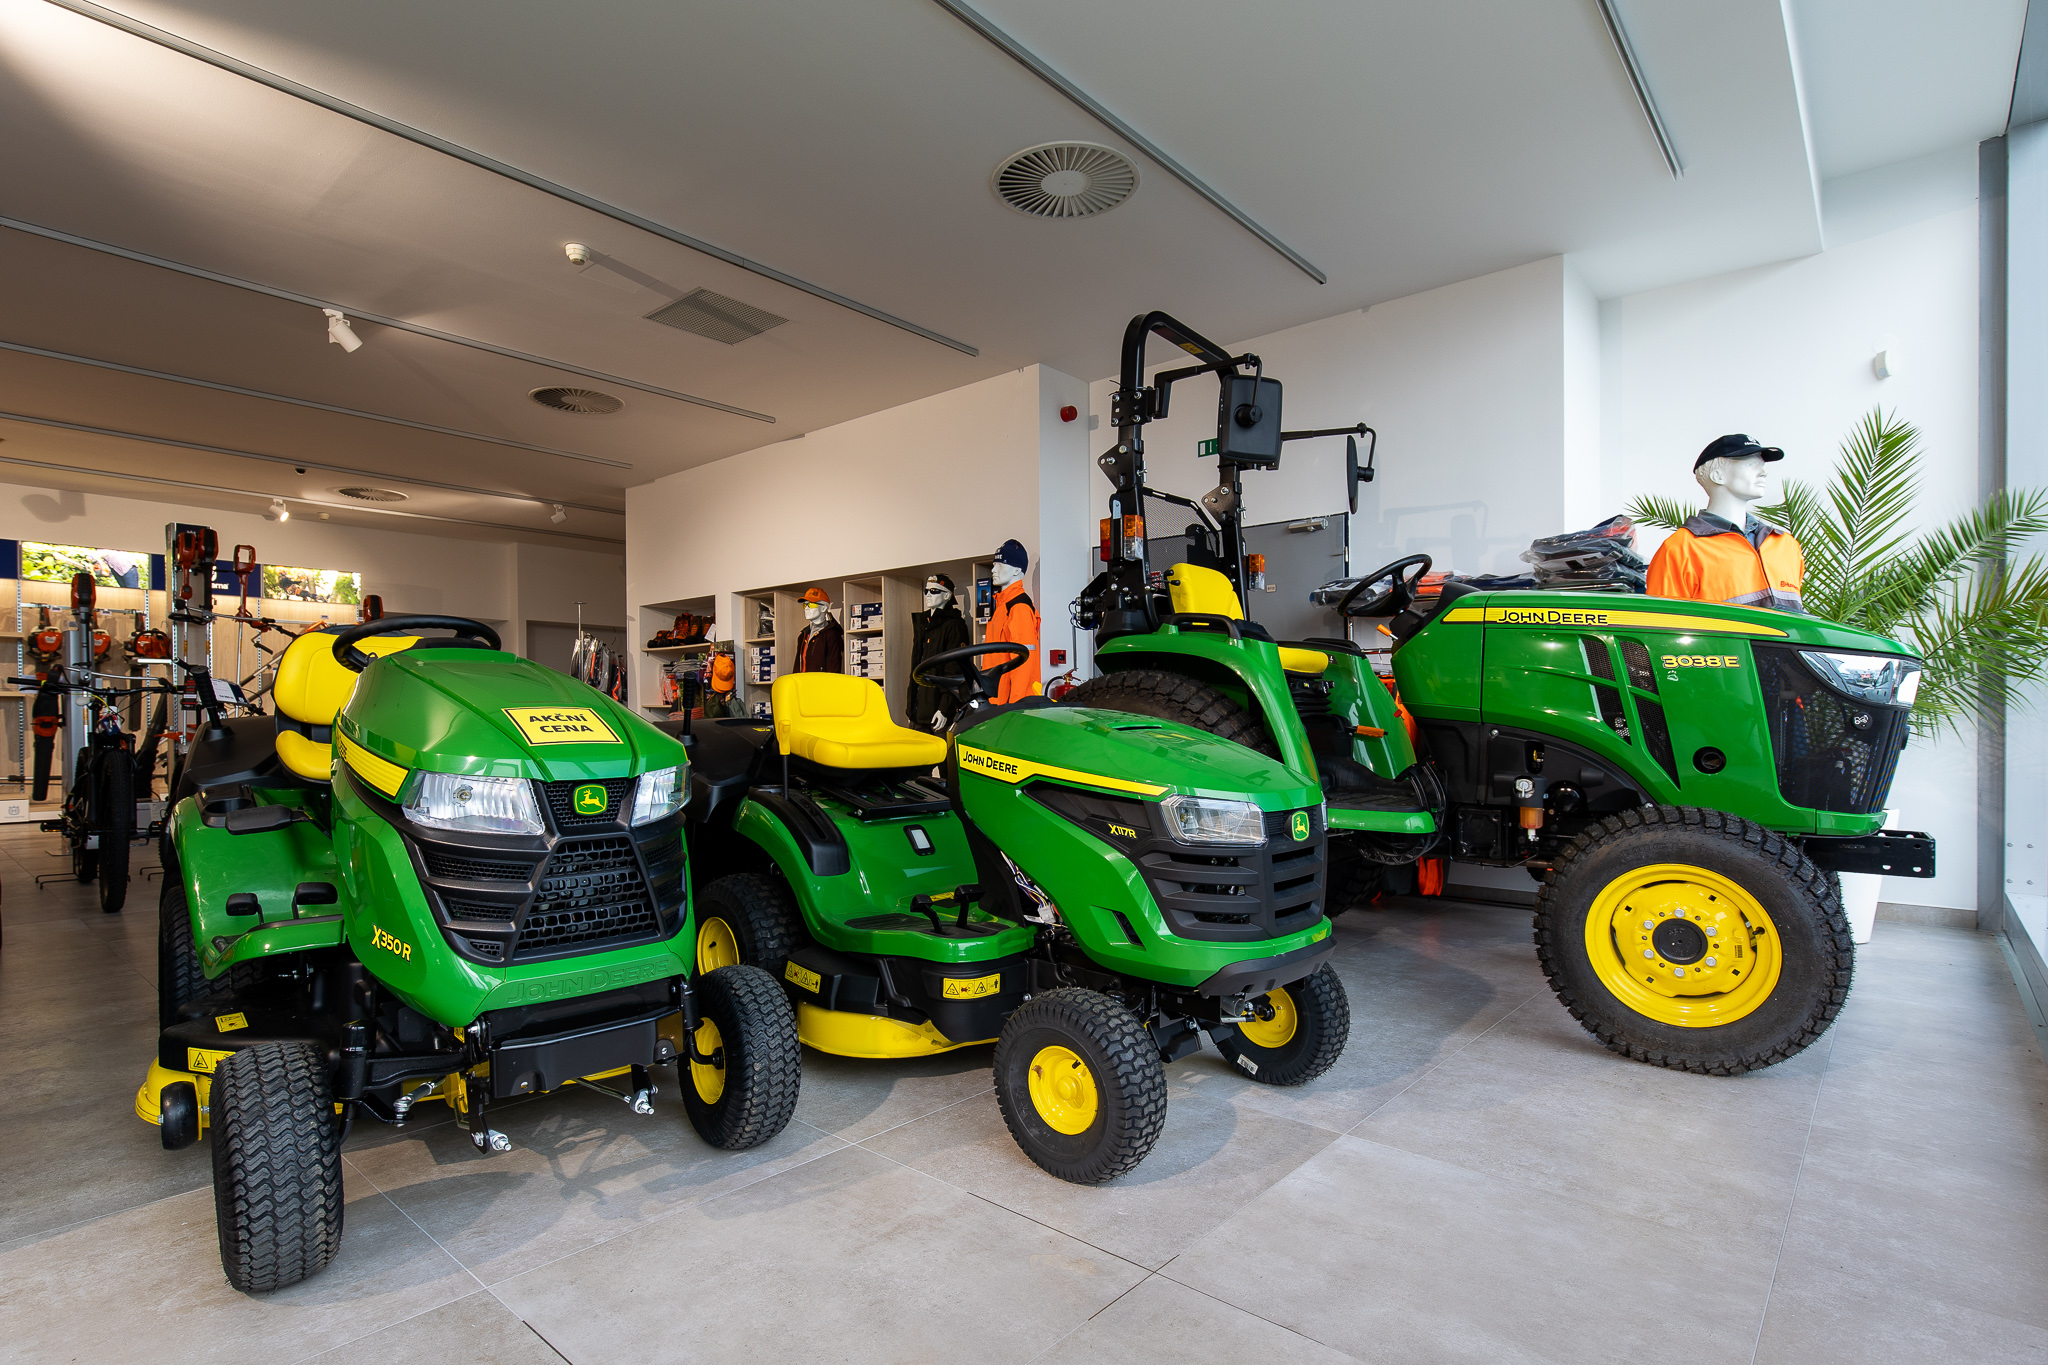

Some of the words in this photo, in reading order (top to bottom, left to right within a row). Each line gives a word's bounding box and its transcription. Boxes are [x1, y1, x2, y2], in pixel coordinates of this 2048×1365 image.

[1497, 609, 1545, 623] JOHN
[1547, 611, 1608, 625] DEERE
[1661, 654, 1741, 669] 3038E
[529, 713, 587, 722] AKČNÍ
[540, 725, 594, 733] CENA
[963, 751, 984, 766] JOHN
[986, 756, 1018, 775] DEERE
[1108, 823, 1137, 839] X117R
[371, 924, 412, 962] X350R
[507, 976, 583, 1004] JOHN
[590, 959, 669, 990] DEERE
